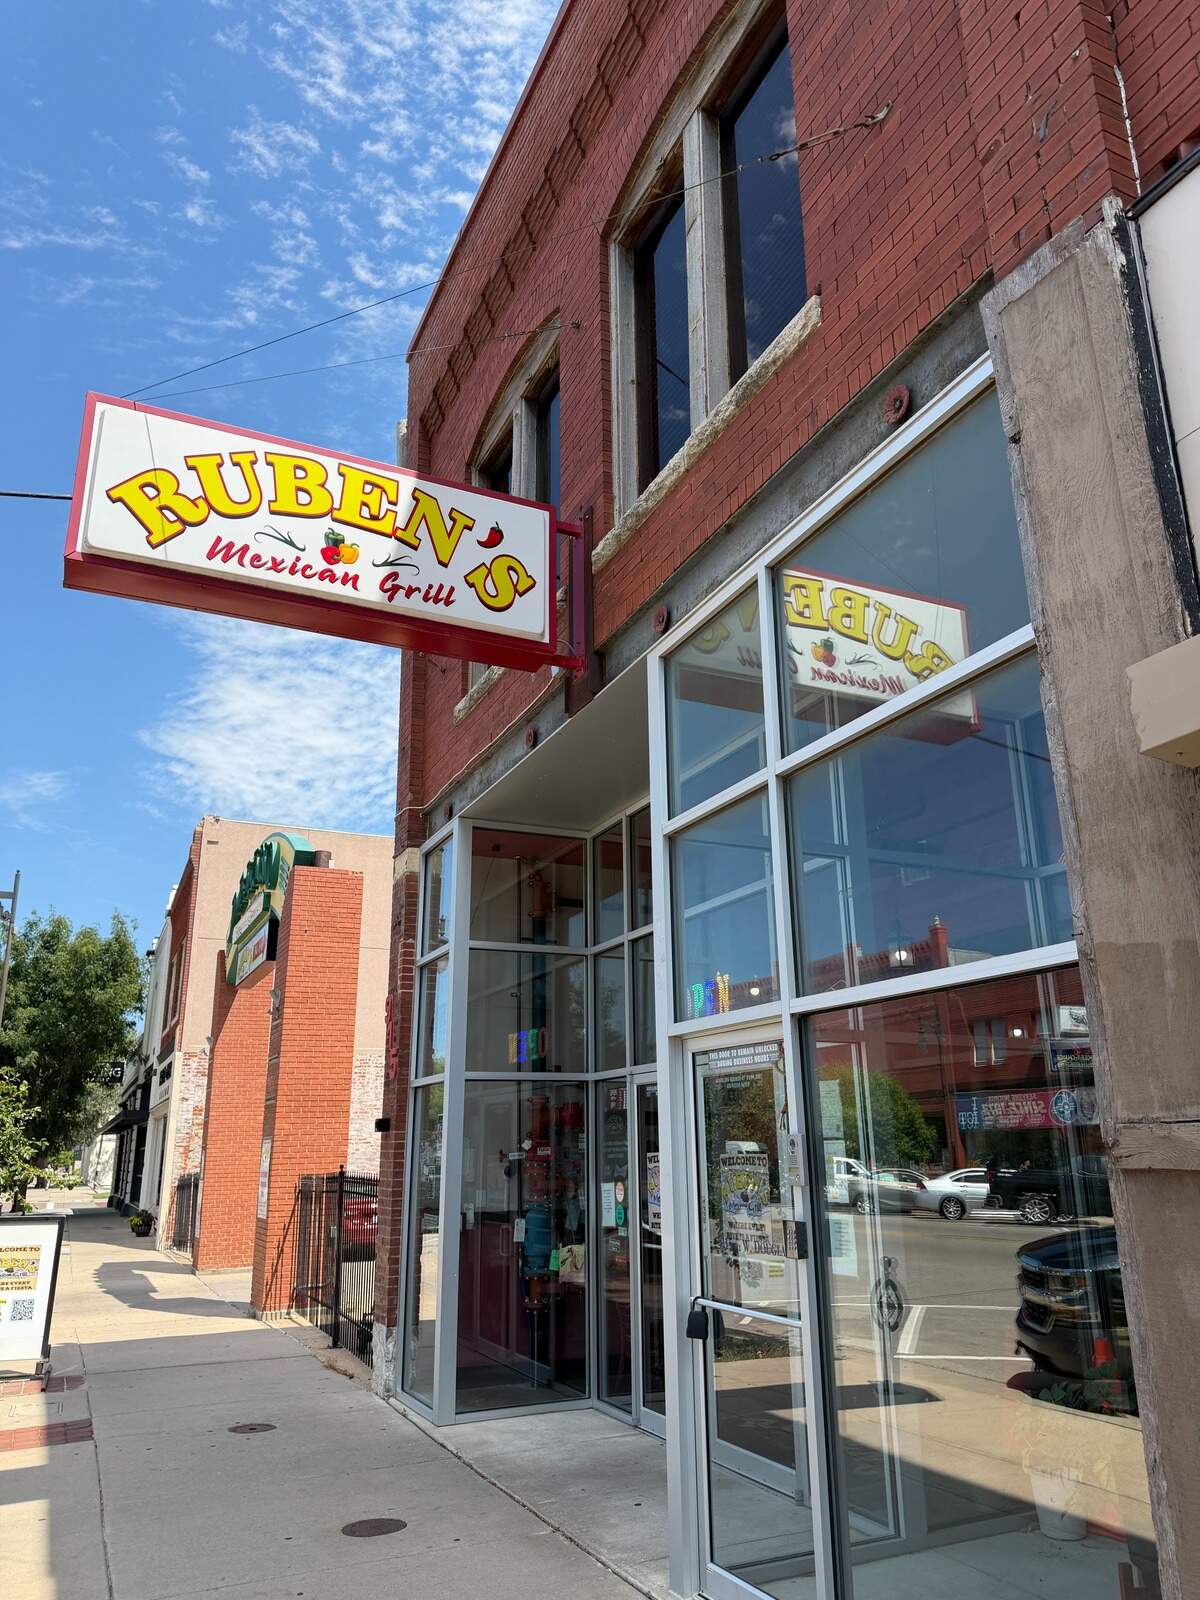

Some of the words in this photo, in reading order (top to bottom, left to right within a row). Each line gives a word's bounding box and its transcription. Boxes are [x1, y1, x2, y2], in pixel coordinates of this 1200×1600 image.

[106, 451, 536, 612] RUBEN'S
[207, 535, 361, 592] Mexican
[378, 571, 456, 608] Grill
[385, 994, 398, 1080] 915
[709, 1052, 718, 1060] THIS
[719, 1050, 731, 1058] DOOR
[731, 1049, 737, 1057] TO
[738, 1046, 754, 1055] REMAIN
[755, 1043, 778, 1053] UNLOCKED
[717, 1058, 732, 1067] DURING
[733, 1056, 753, 1065] BUSINESS
[754, 1053, 769, 1063] HOURS
[102, 1067, 122, 1078] NG
[720, 1155, 756, 1167] WELCOME
[756, 1155, 768, 1167] TO
